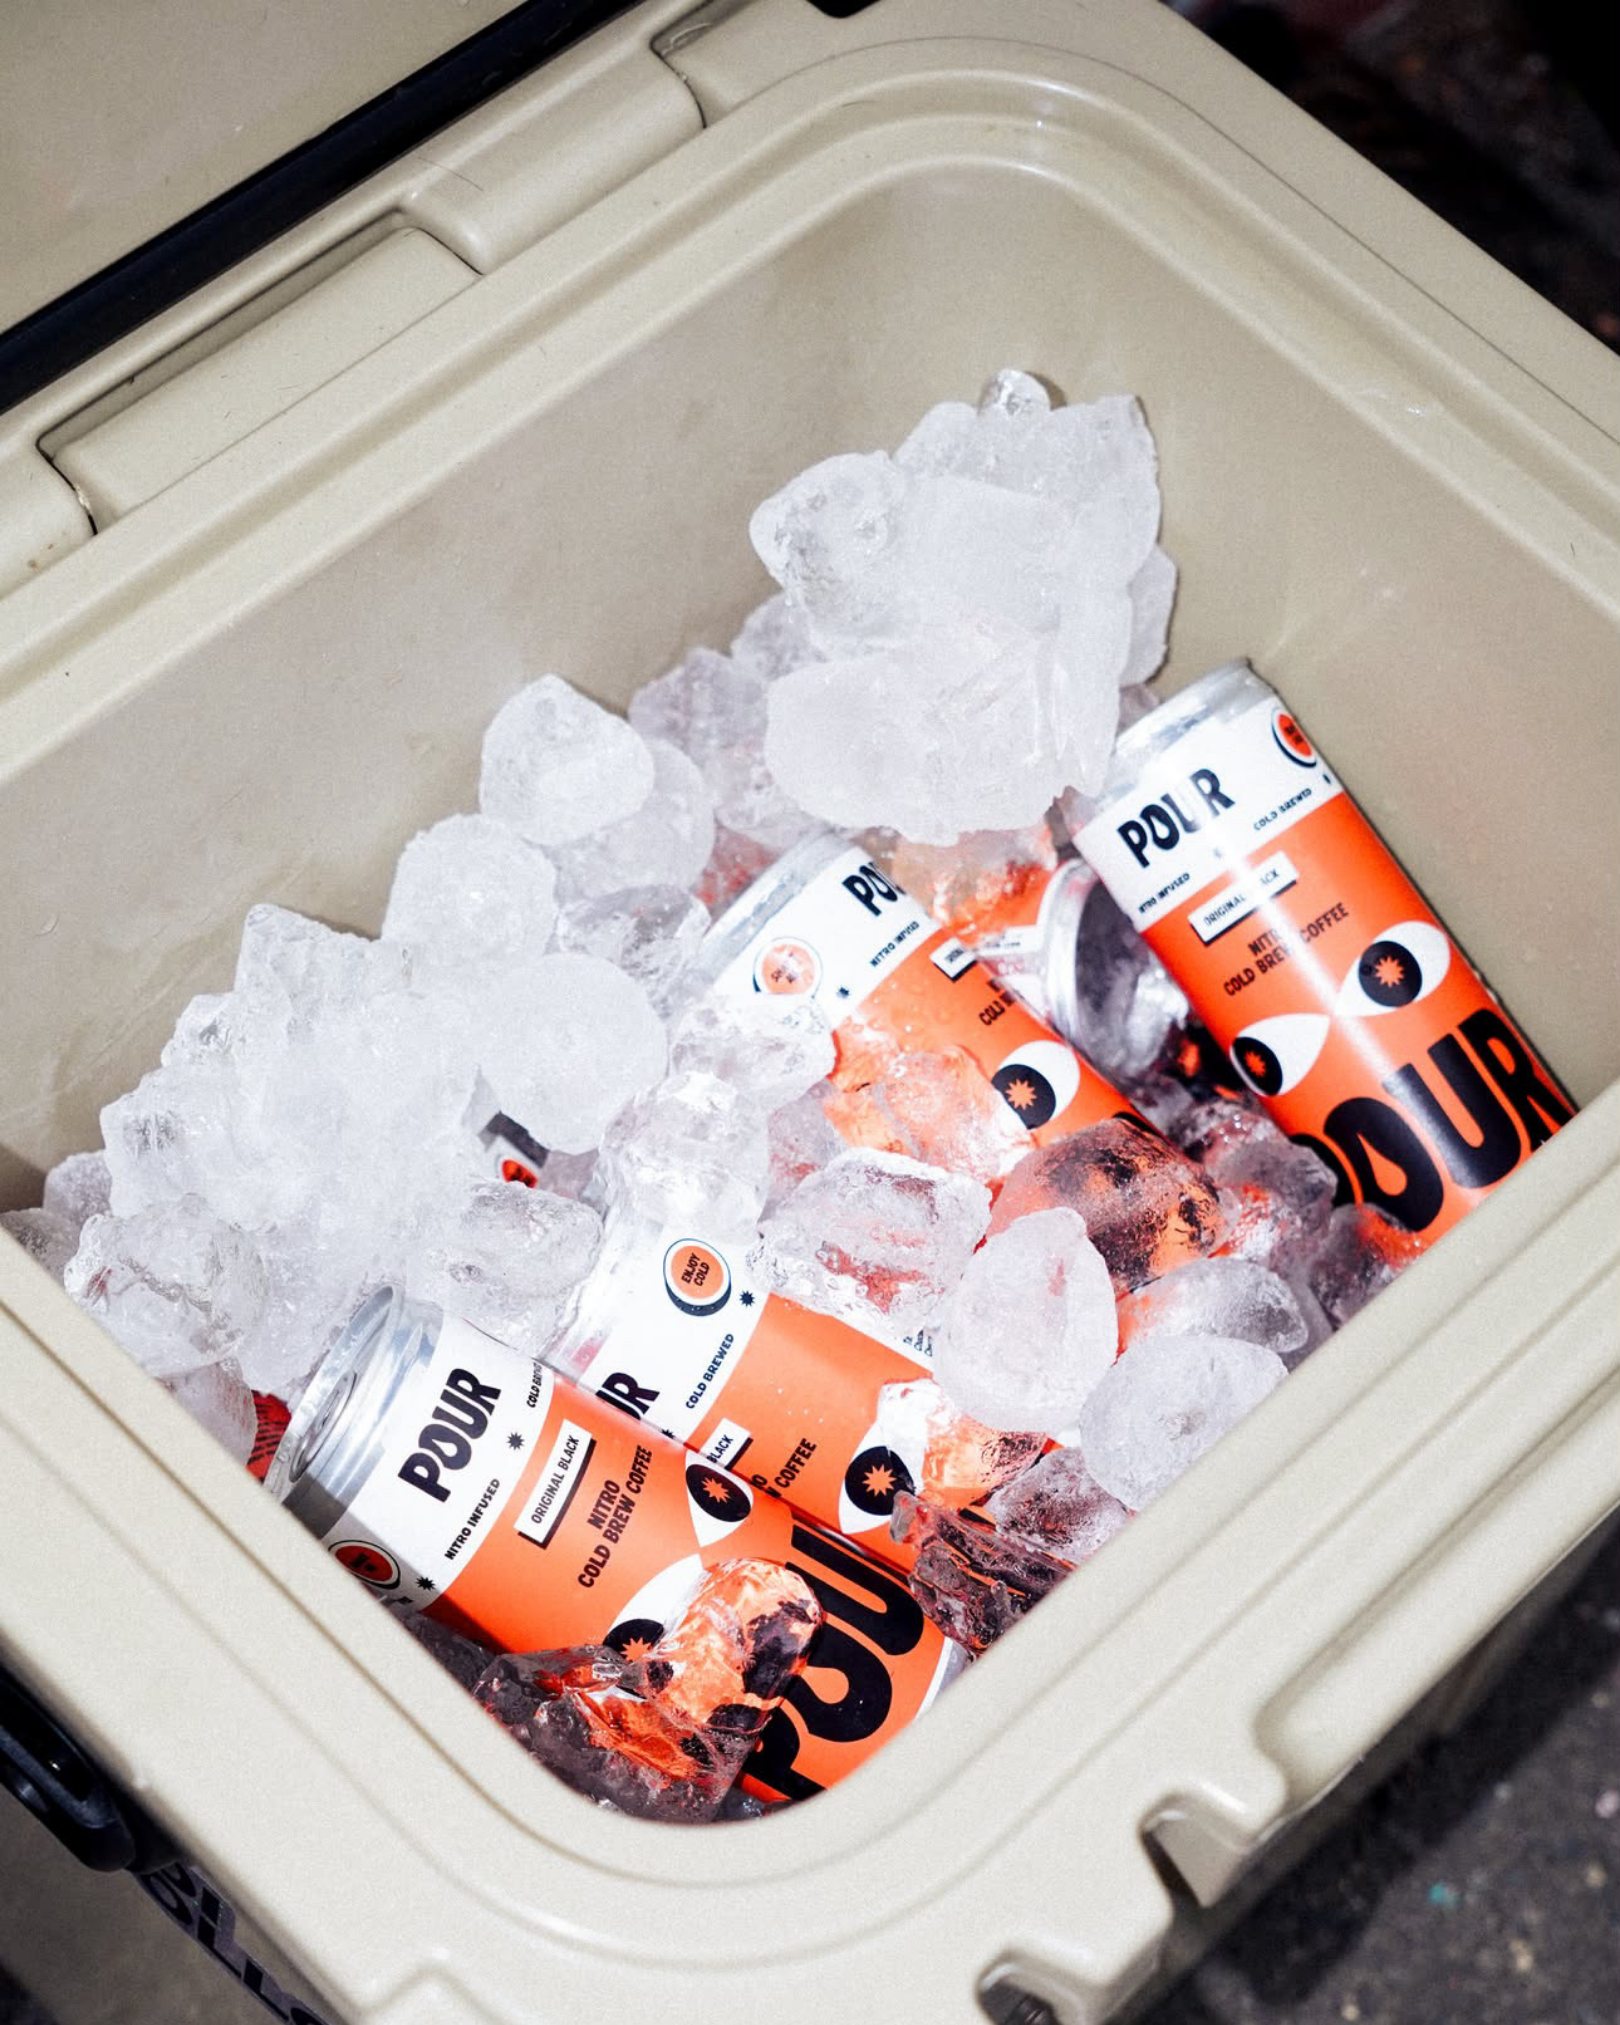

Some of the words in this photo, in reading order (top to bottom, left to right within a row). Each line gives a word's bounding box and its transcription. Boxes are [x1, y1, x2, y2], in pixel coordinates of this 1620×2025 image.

[1117, 768, 1236, 869] POUR
[842, 862, 907, 916] PO
[1203, 893, 1246, 926] ORIGINAL
[1223, 967, 1256, 996] COLD
[1299, 902, 1349, 943] COFFEE
[1248, 928, 1282, 957] NITR
[681, 1252, 701, 1284] ENJOY
[693, 1261, 711, 1287] COLD
[526, 1386, 541, 1408] COLD
[686, 1381, 707, 1409] COLD
[703, 1333, 735, 1383] BREWED
[397, 1368, 502, 1503] POUR
[706, 1434, 734, 1464] BLACK
[530, 1472, 566, 1524] ORIGINAL
[557, 1434, 580, 1472] BLACK
[775, 1437, 818, 1488] COFFEE
[444, 1526, 472, 1560] NITRO
[467, 1478, 501, 1528] INFUSED
[577, 1544, 611, 1588] COLD
[602, 1493, 636, 1544] BREW
[625, 1444, 653, 1494] COFFEE
[586, 1479, 621, 1530] NITRO
